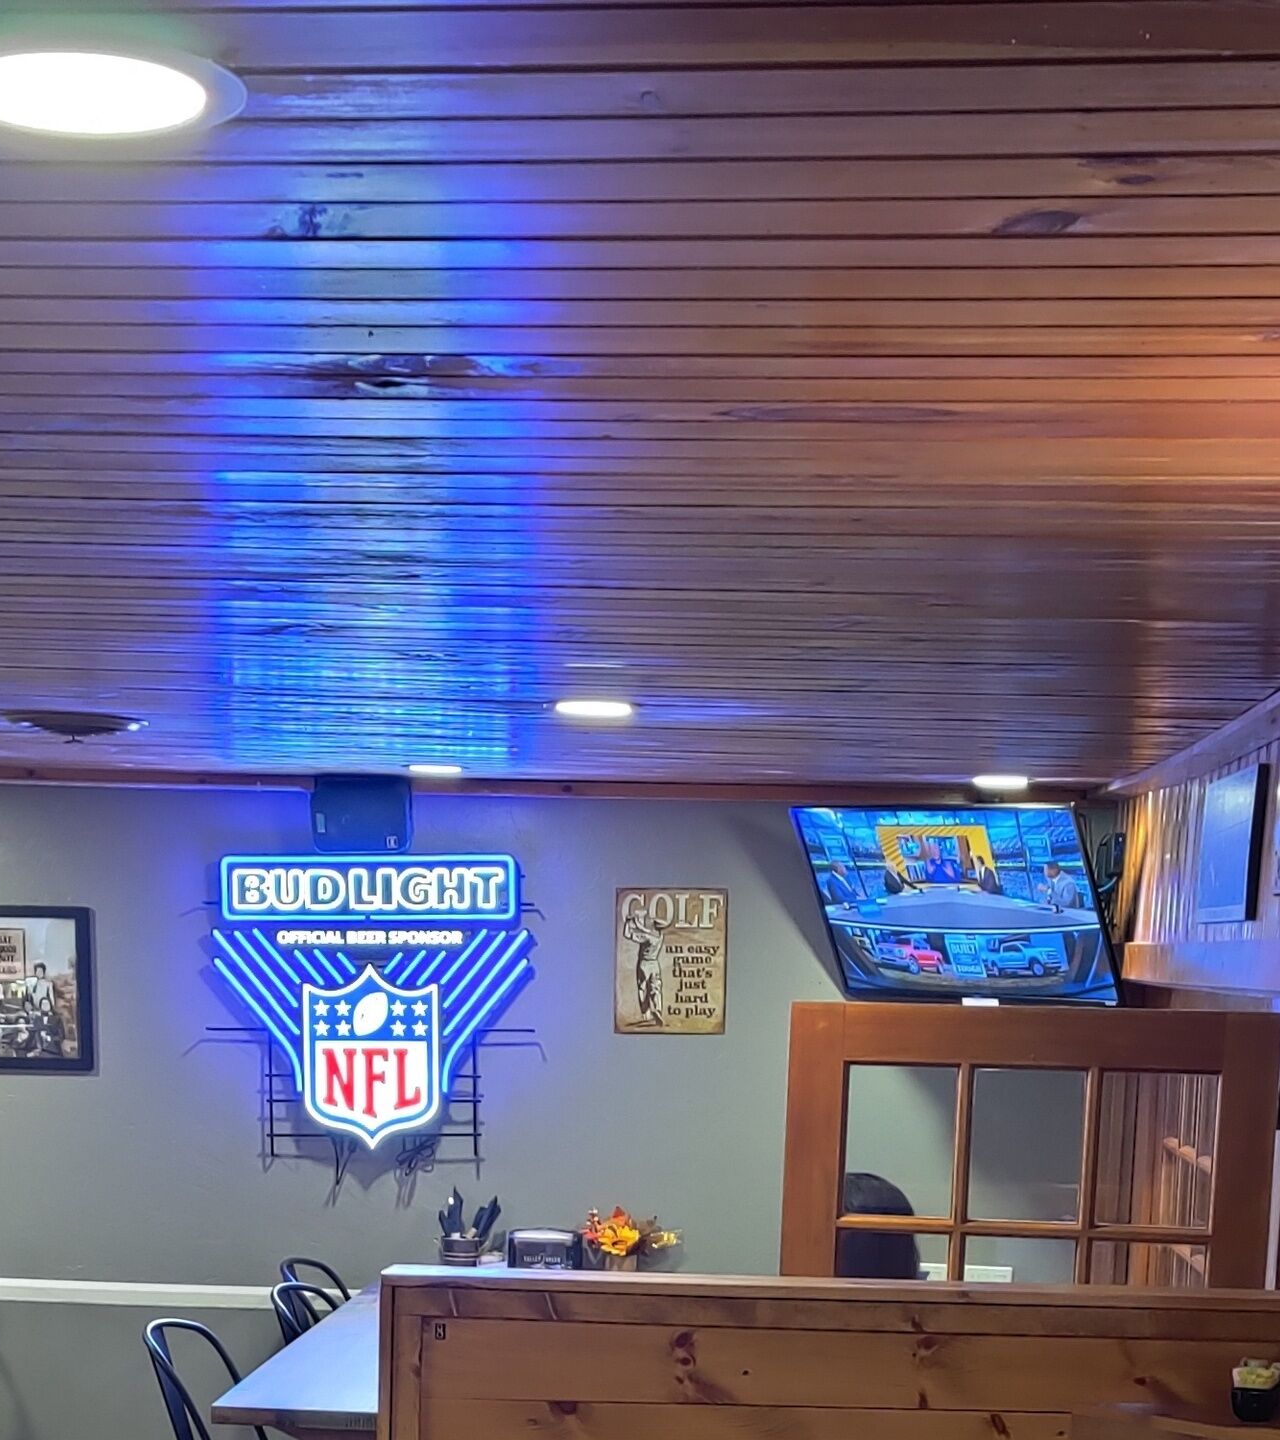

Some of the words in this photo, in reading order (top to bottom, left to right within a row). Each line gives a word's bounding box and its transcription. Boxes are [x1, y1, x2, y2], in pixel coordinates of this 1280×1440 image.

[233, 868, 345, 910] BUD
[348, 867, 505, 910] LIGHT
[621, 893, 724, 929] GOLF
[276, 930, 345, 944] OFFICIAL
[346, 930, 386, 945] BEER
[388, 930, 463, 945] SPONSOR
[665, 945, 683, 954] an
[687, 945, 720, 956] easy
[672, 955, 712, 967] game
[672, 964, 712, 979] that's
[677, 979, 706, 992] just
[674, 992, 708, 1003] hard
[667, 1004, 681, 1015] to
[685, 1004, 716, 1018] play
[322, 1048, 421, 1118] NFL
